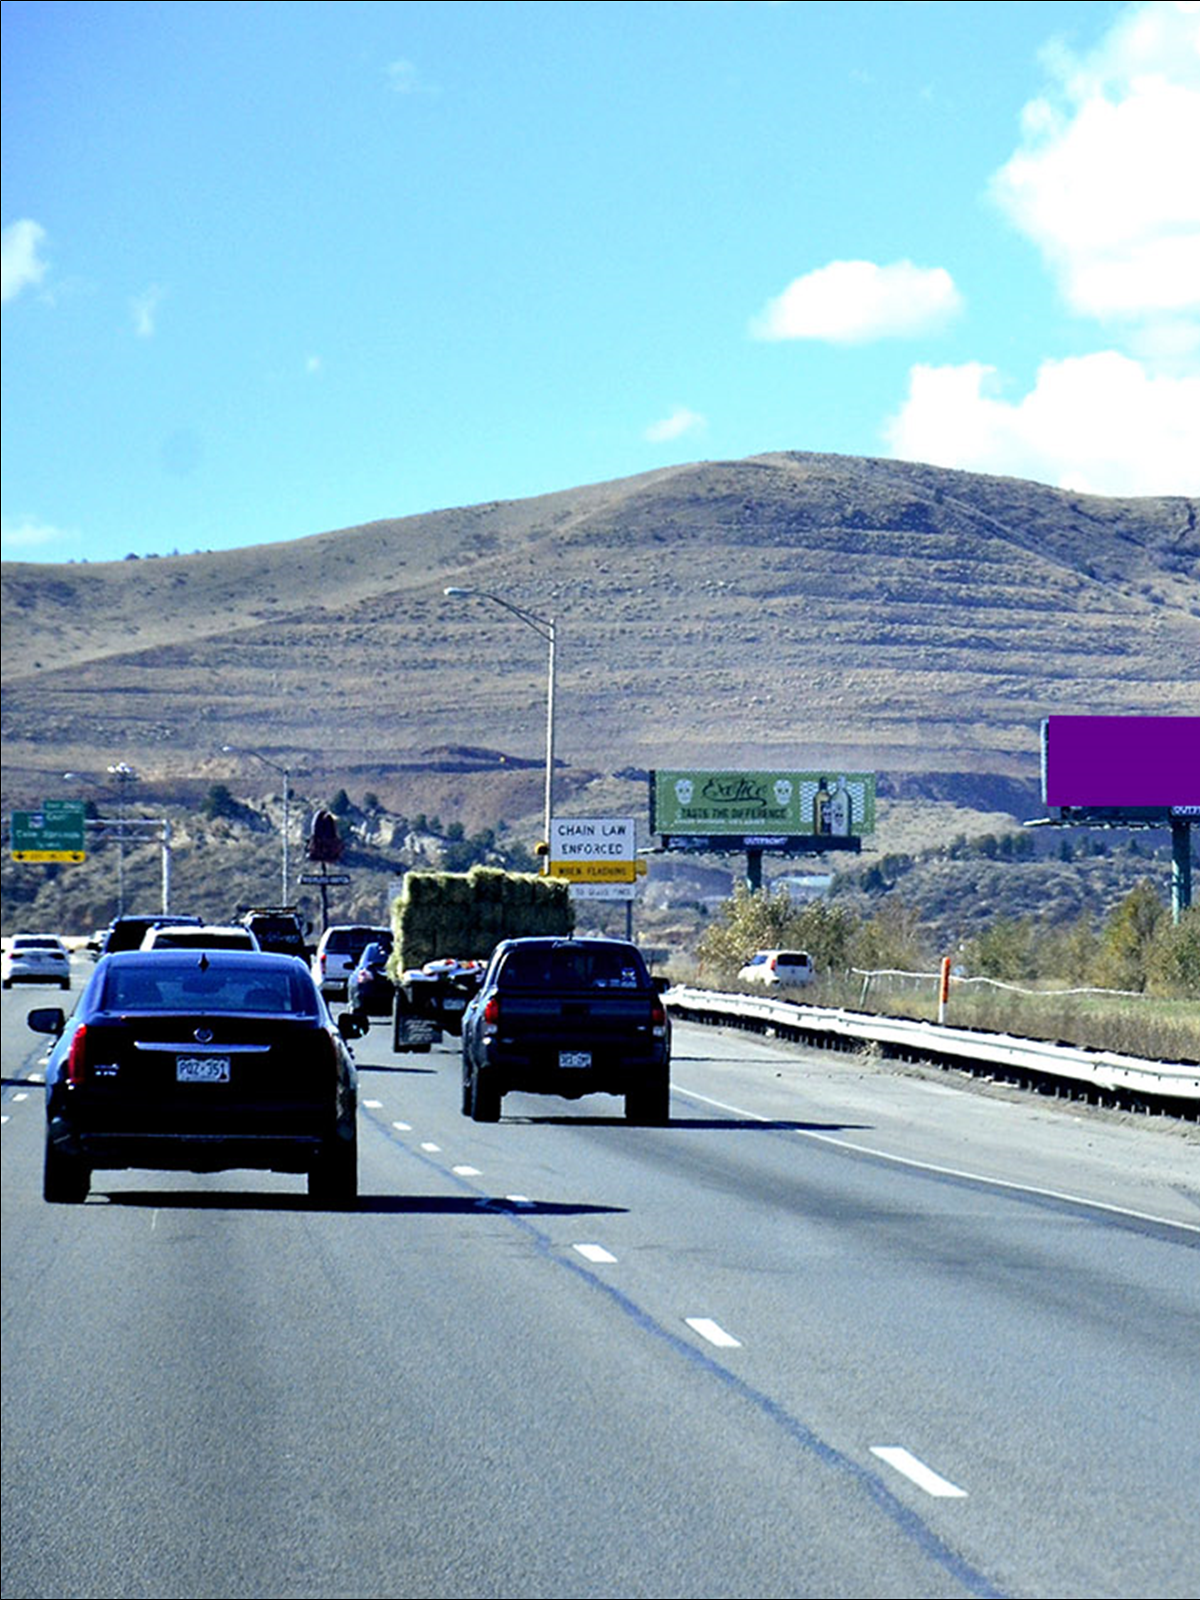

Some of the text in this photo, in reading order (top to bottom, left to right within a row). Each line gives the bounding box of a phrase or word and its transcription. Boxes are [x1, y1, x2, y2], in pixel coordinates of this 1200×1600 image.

[712, 808, 730, 819] THE
[731, 808, 788, 819] DIFFERENCE
[558, 825, 626, 836] CHAIN LAW
[561, 843, 623, 855] ENFORCED
